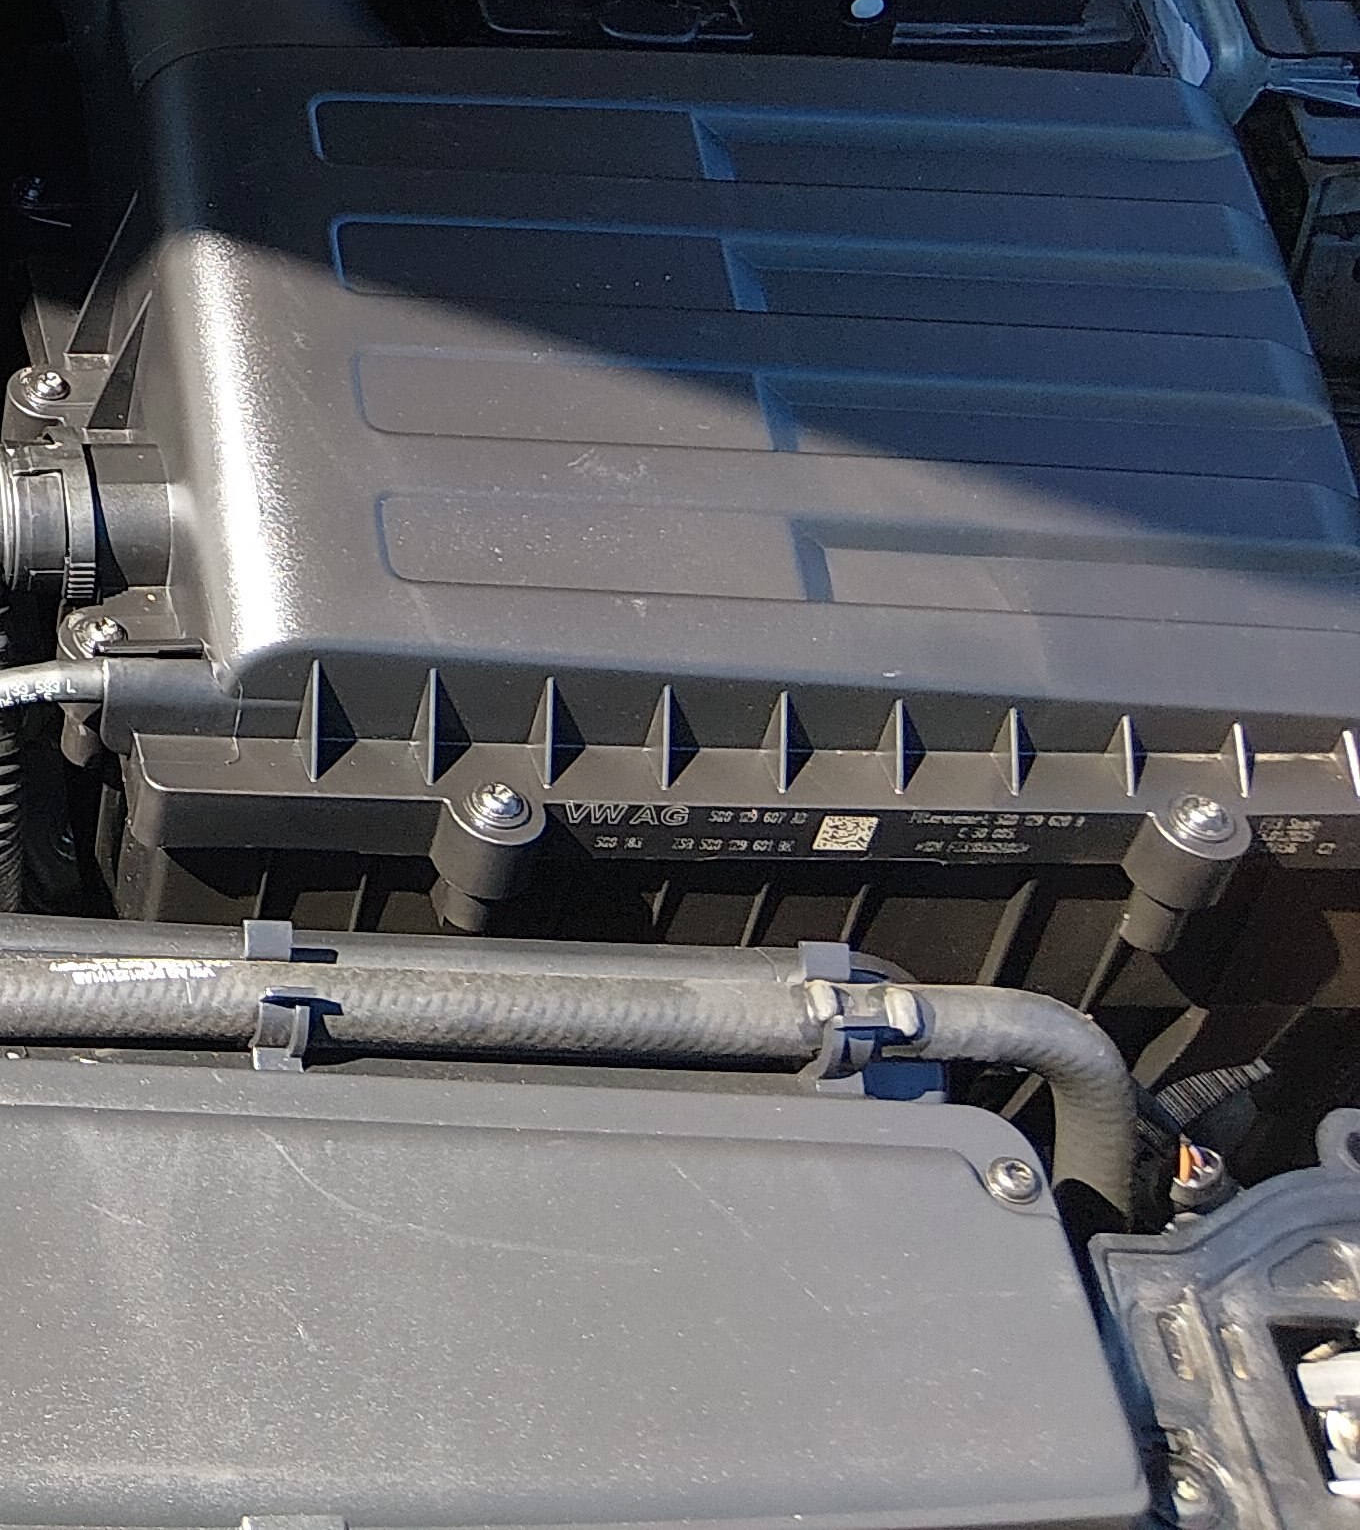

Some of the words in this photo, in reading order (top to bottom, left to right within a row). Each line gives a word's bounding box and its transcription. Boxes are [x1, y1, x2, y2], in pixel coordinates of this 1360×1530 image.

[66, 679, 77, 694] L
[565, 801, 629, 825] VW
[630, 805, 690, 826] AG
